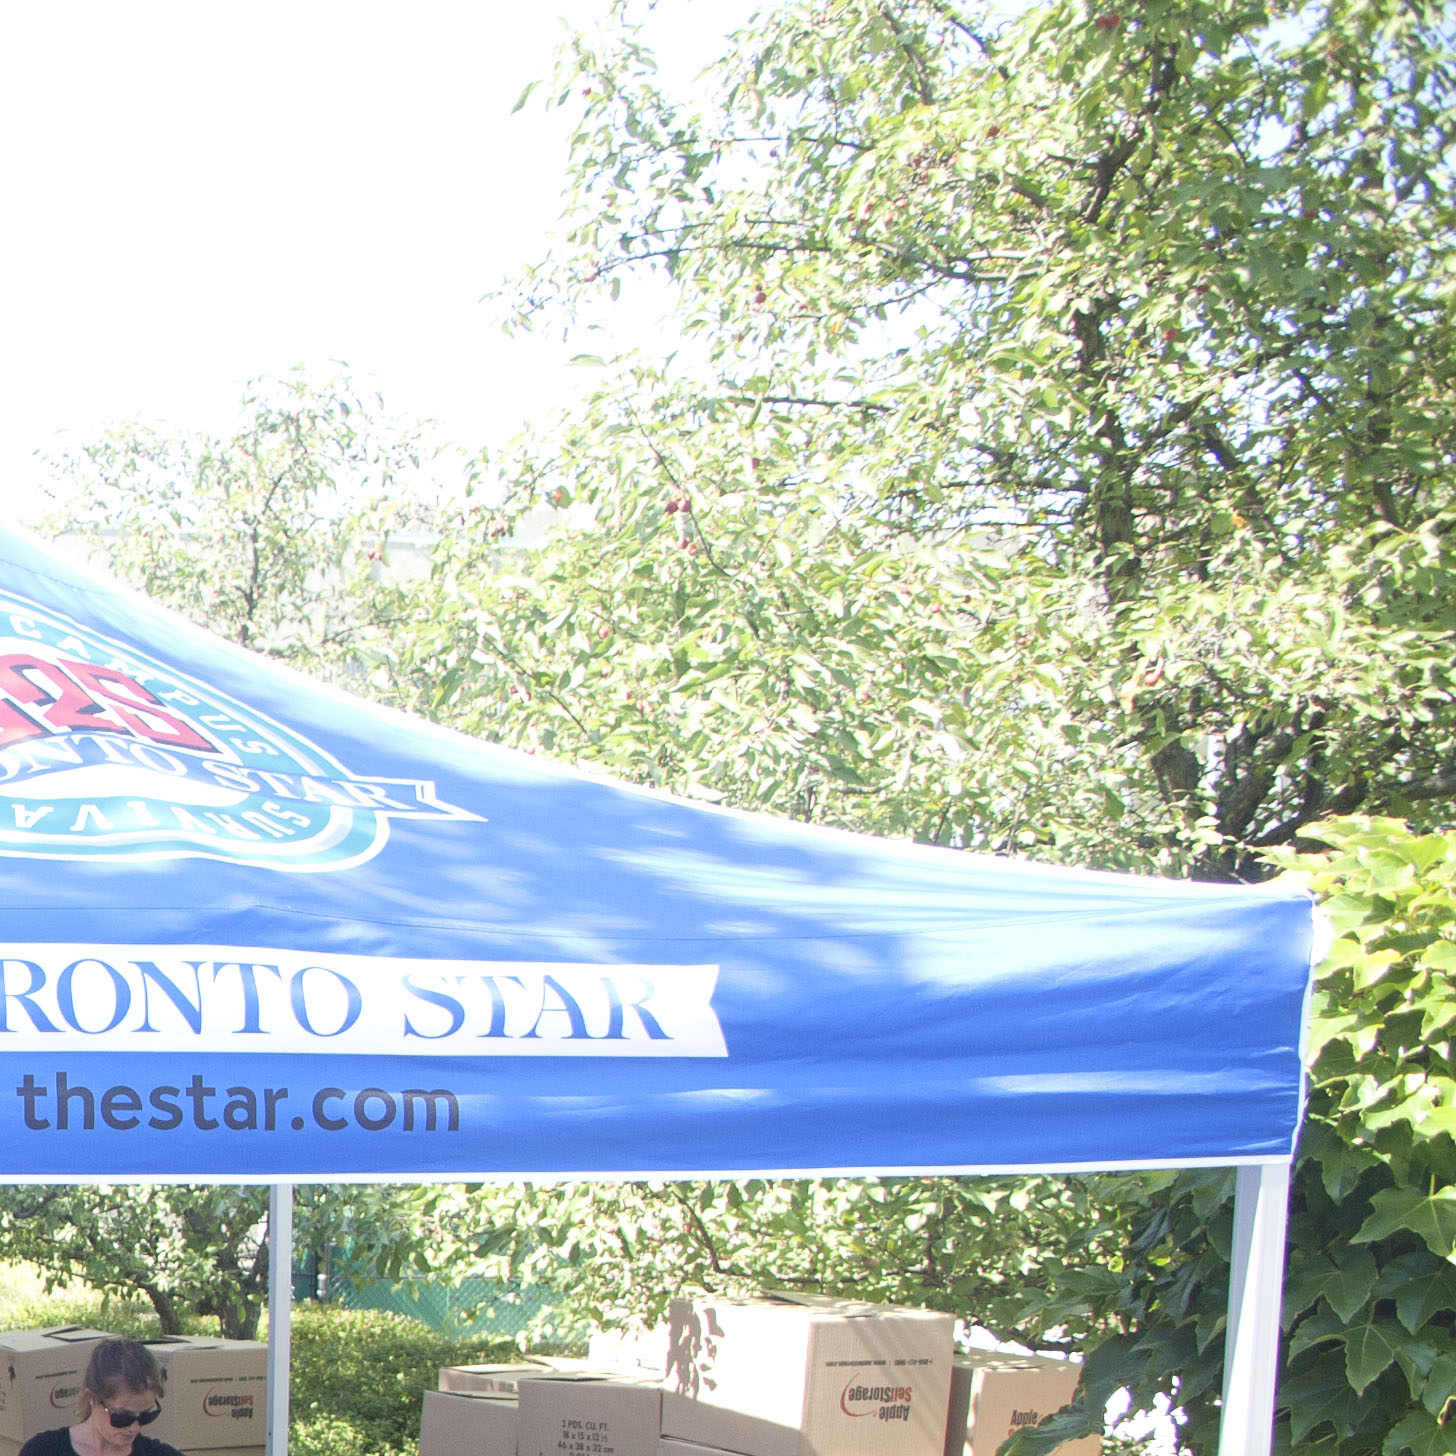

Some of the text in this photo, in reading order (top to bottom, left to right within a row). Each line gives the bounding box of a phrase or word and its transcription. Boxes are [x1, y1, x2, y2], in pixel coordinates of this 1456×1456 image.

[9, 614, 279, 756] CAMPUS
[202, 760, 417, 810] STAR
[401, 967, 675, 1040] STAR
[16, 1072, 459, 1132] thestar.com
[849, 1386, 913, 1402] SelfStorage
[231, 1407, 254, 1419] Apple
[879, 1404, 911, 1422] Apple
[1010, 1409, 1038, 1427] Apple
